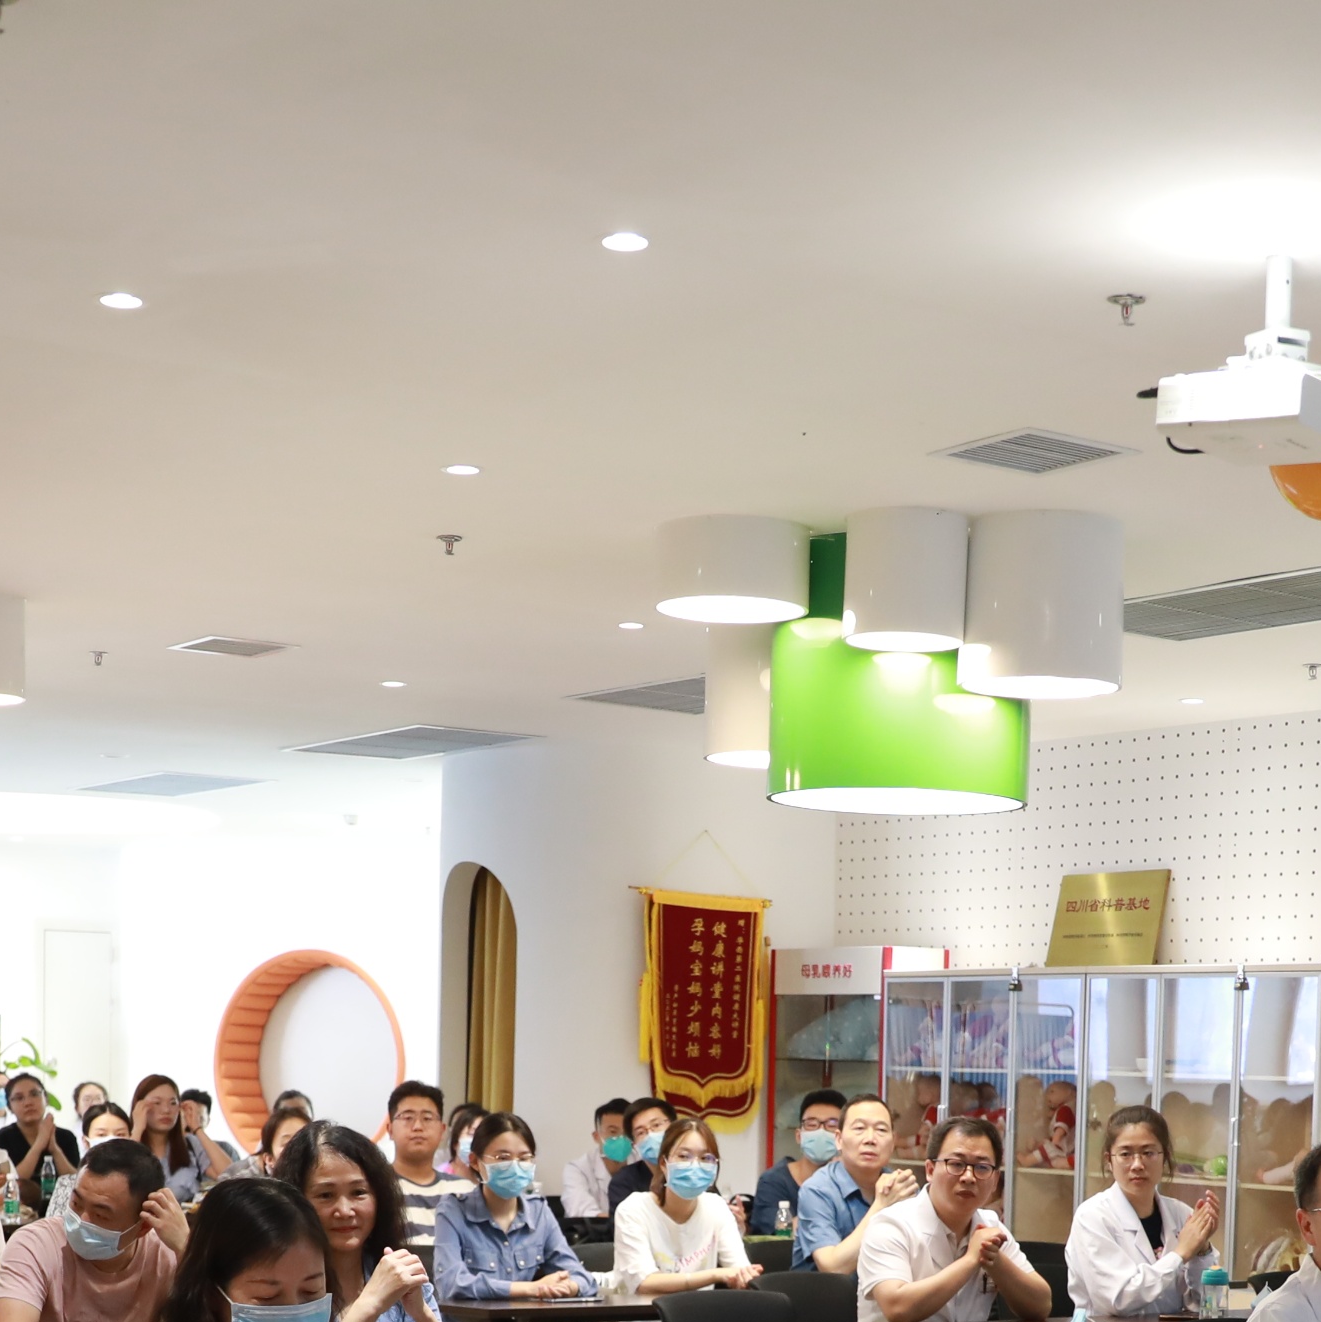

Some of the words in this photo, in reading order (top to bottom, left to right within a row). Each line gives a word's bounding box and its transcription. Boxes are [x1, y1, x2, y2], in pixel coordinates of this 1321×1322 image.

[1065, 897, 1151, 913] 四川省科普基地
[801, 964, 854, 979] 母乳喂养好
